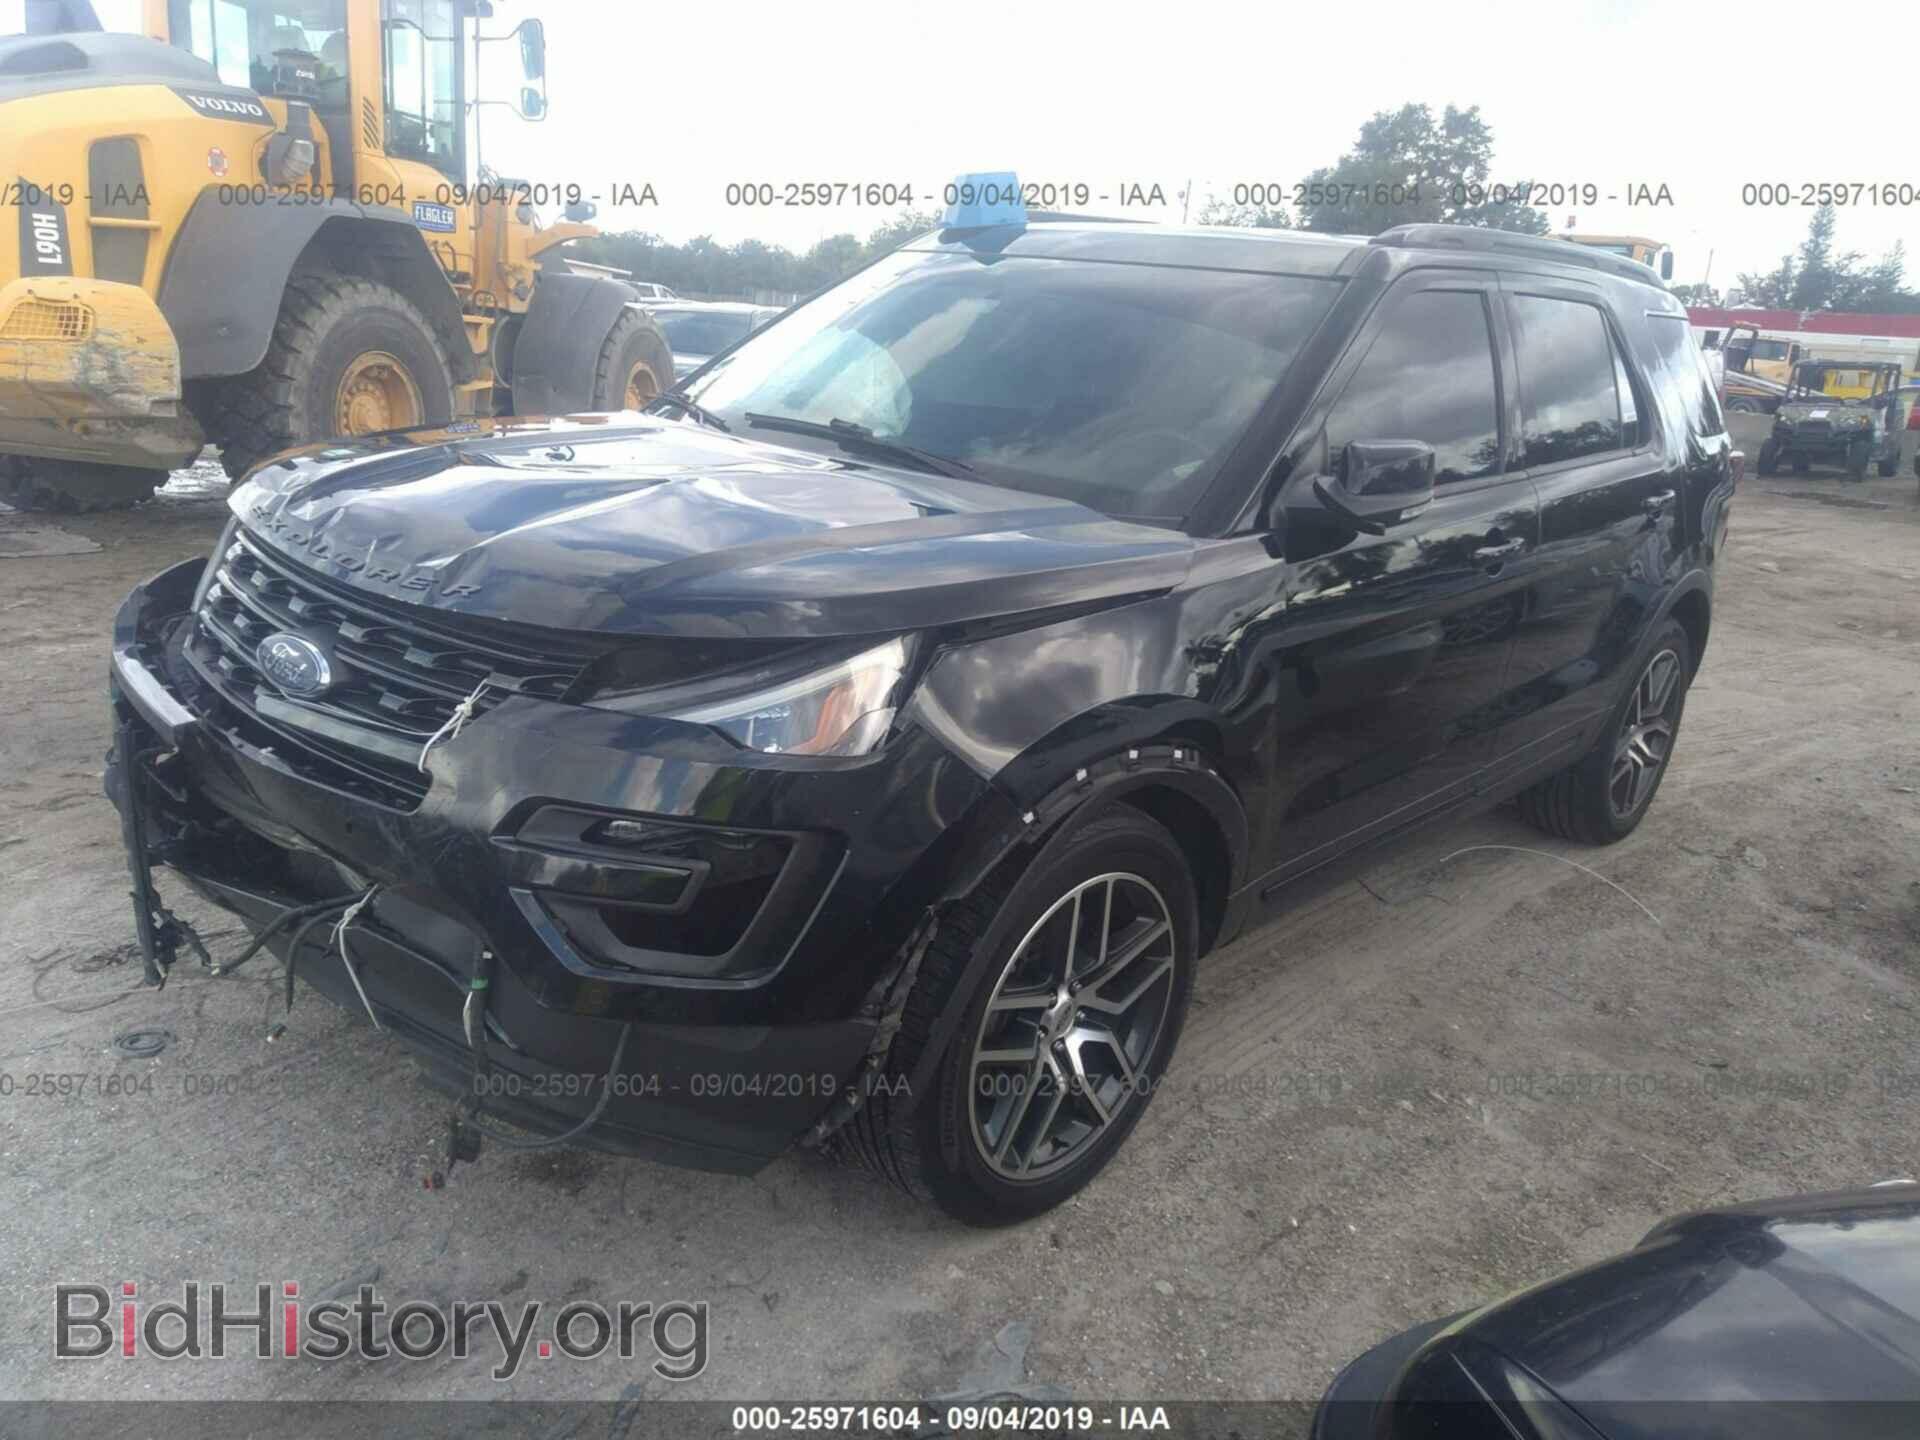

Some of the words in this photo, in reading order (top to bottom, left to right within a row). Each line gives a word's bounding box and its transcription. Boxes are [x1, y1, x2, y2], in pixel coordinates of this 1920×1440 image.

[186, 95, 263, 117] VOLVO
[415, 205, 454, 225] FLAGLER
[31, 212, 63, 265] L90H
